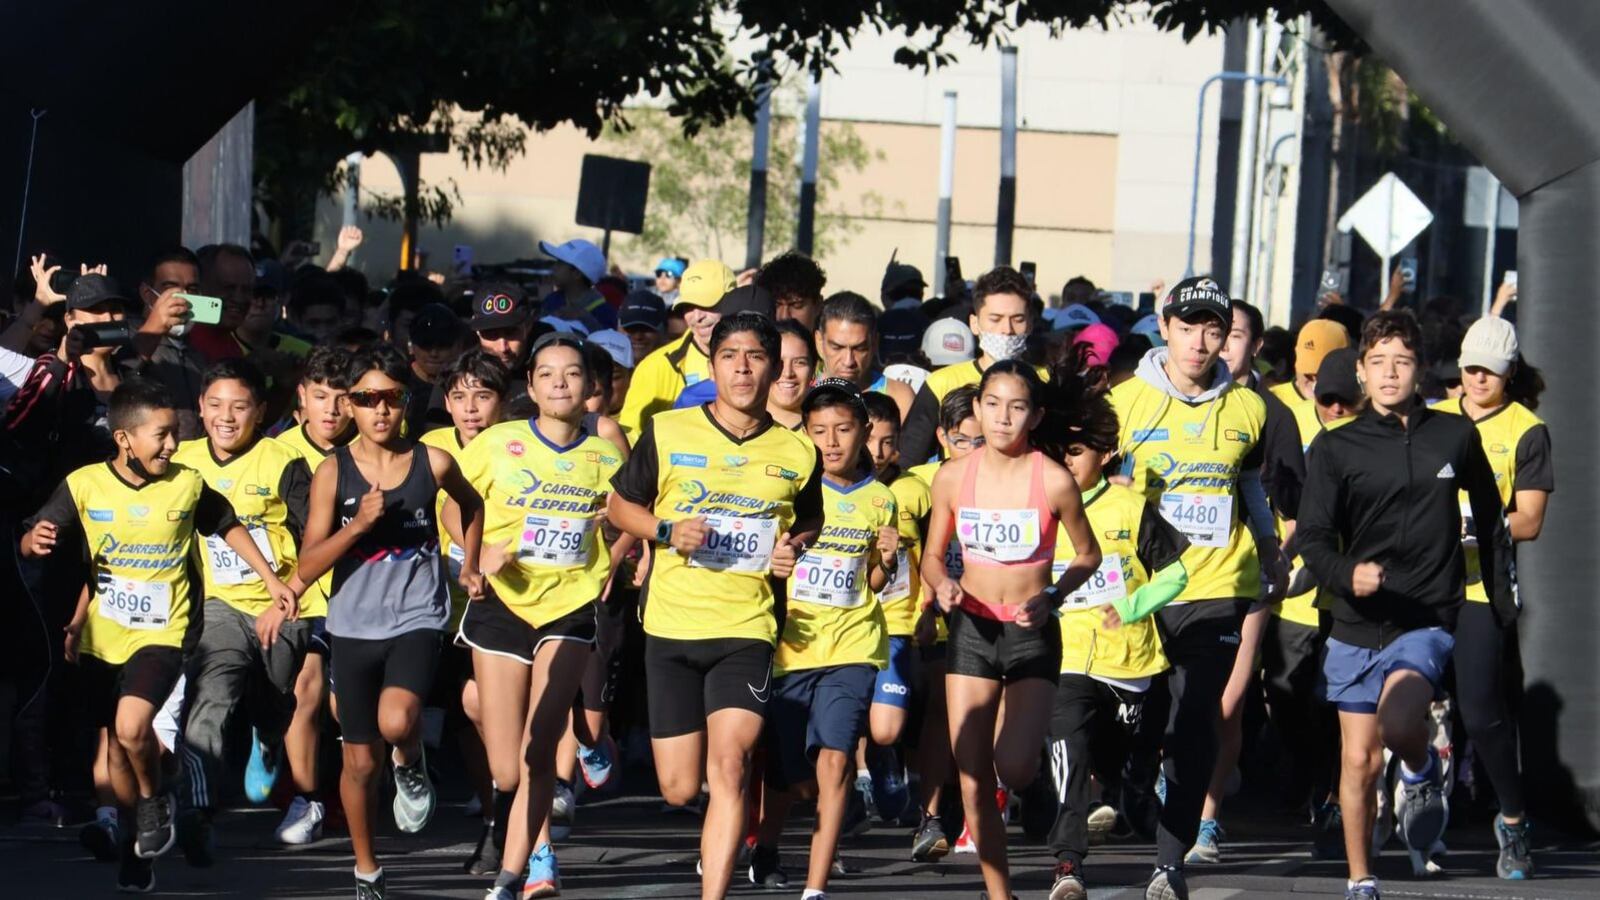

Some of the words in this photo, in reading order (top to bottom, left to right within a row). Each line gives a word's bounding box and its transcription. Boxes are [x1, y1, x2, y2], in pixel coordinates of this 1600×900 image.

[506, 496, 527, 507] LA
[674, 502, 694, 514] LA
[709, 492, 765, 510] CARRERA
[1172, 503, 1218, 525] 4480
[534, 528, 582, 551] 0759
[707, 527, 759, 553] 0486
[971, 522, 1020, 544] 1730
[808, 566, 855, 590] 0766
[107, 587, 152, 613] 3696
